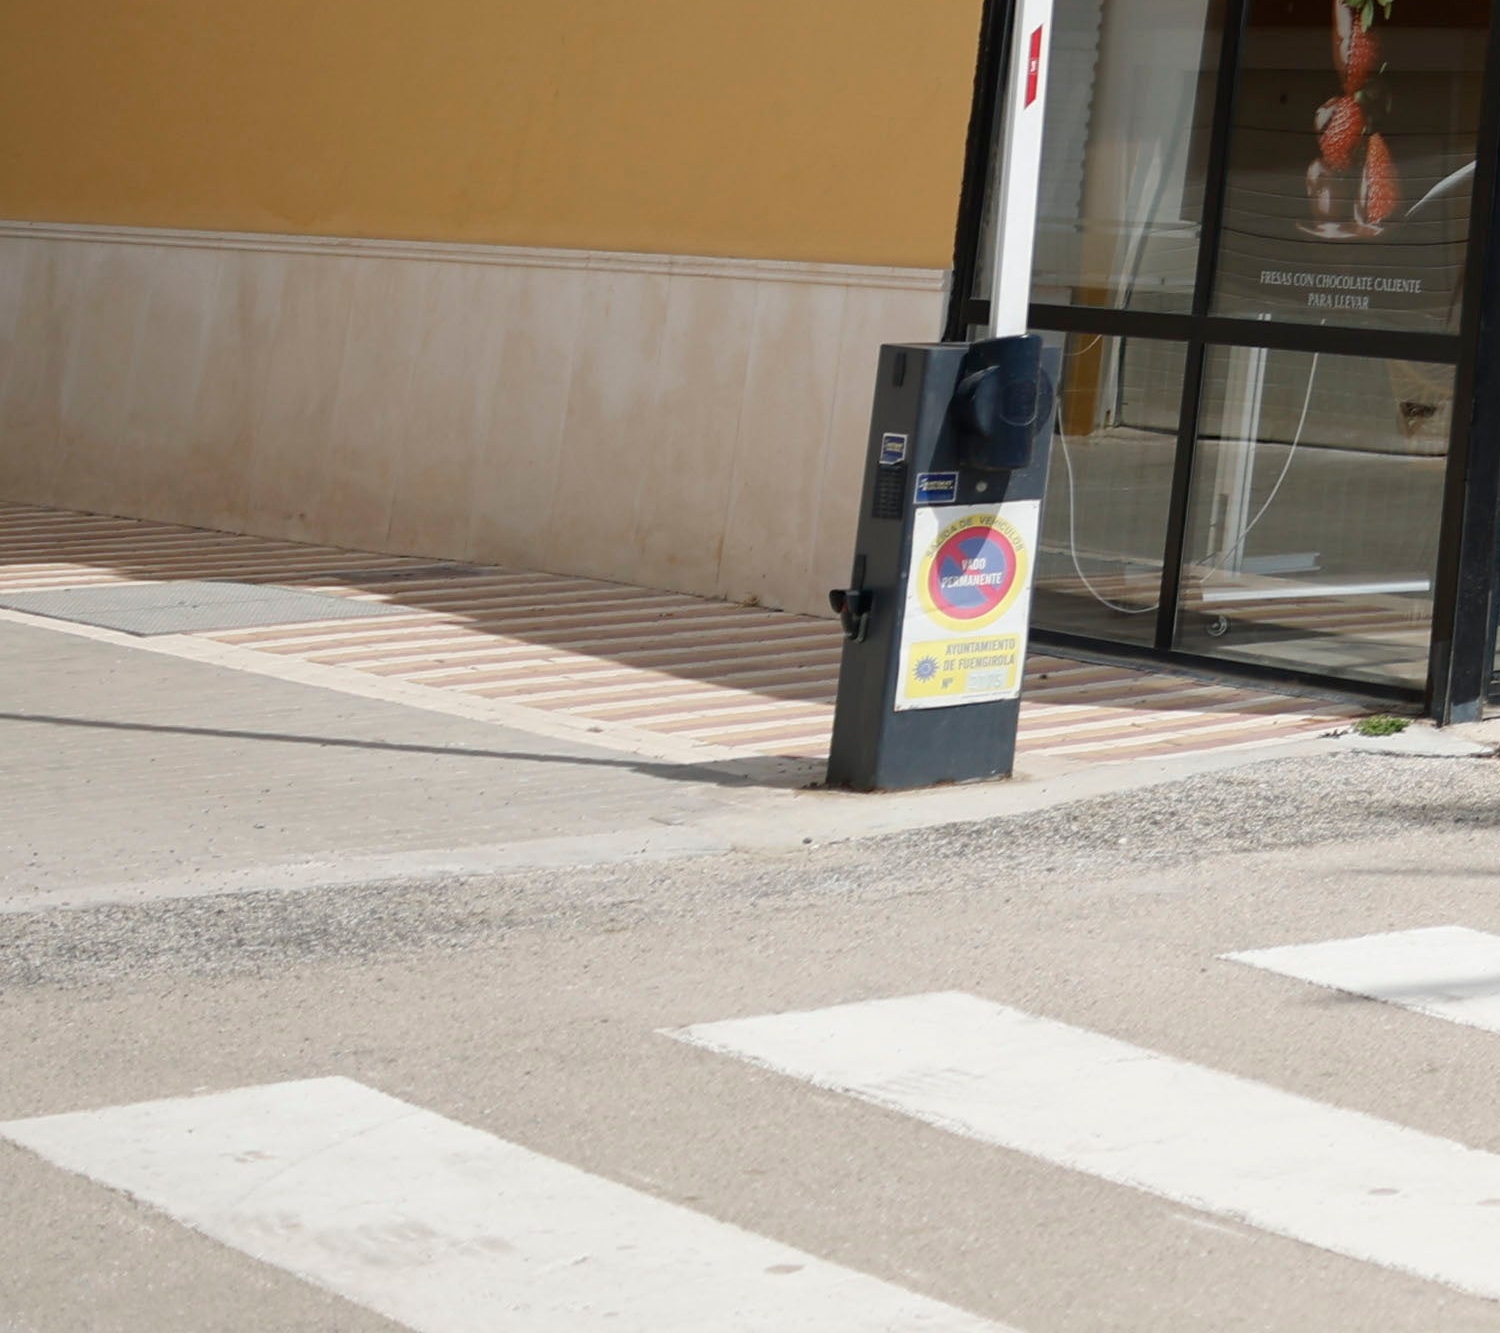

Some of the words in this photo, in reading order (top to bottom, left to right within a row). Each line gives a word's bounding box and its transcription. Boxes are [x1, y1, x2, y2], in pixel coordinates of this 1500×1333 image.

[1260, 270, 1293, 286] FRESAS
[1293, 272, 1315, 287] CON
[1315, 274, 1374, 291] CHOCOLATE
[1374, 277, 1423, 294] CALIENTE
[1307, 292, 1333, 308] PARA
[1334, 295, 1370, 310] LLEVAR
[961, 557, 987, 571] VADO
[941, 571, 1003, 589] PERMANENTE
[945, 638, 1016, 656] AYUNTAMIENTO
[943, 659, 955, 672] DE
[957, 654, 1016, 671] FUENGIROLA
